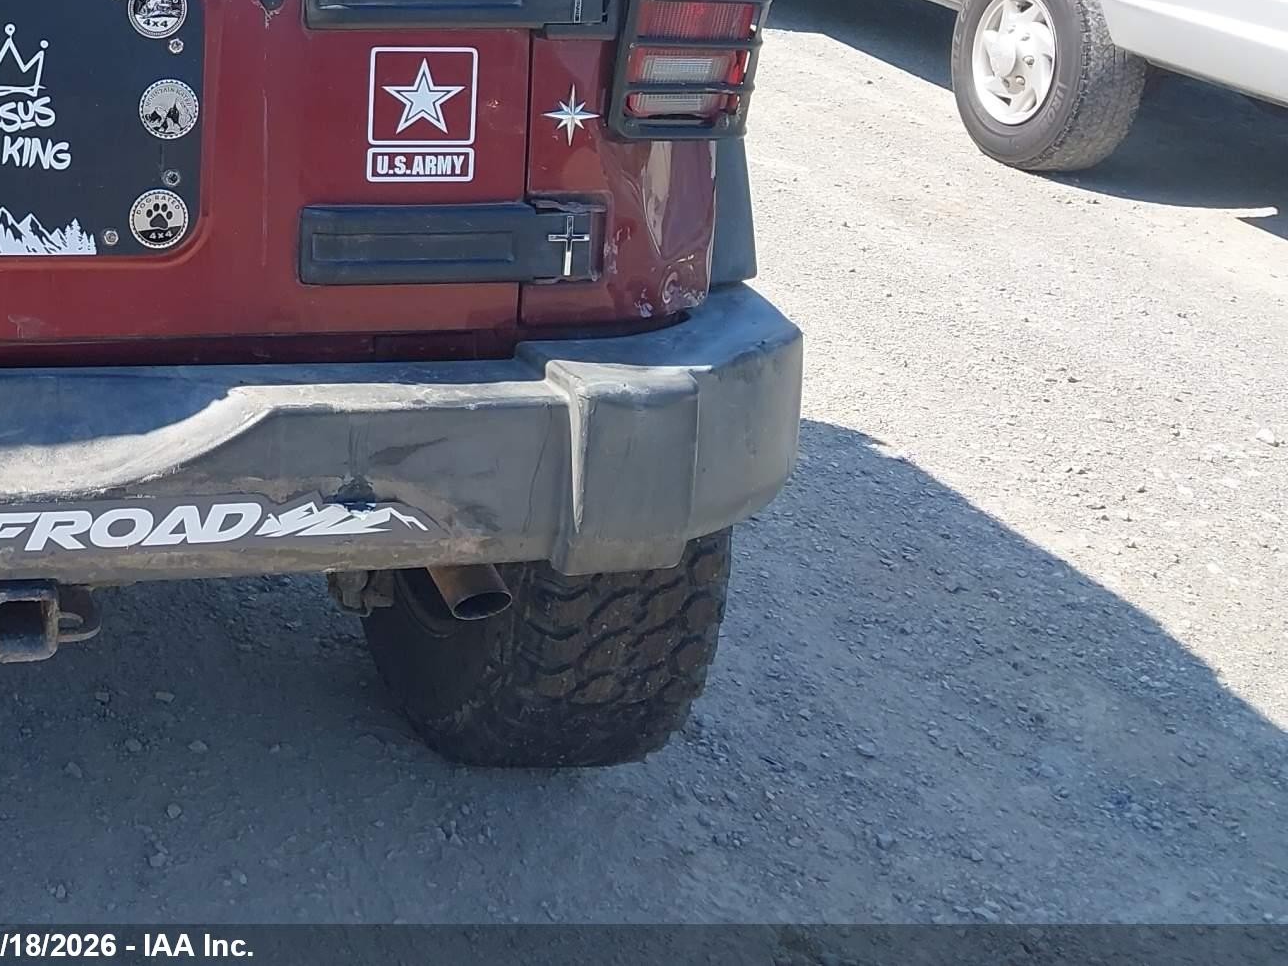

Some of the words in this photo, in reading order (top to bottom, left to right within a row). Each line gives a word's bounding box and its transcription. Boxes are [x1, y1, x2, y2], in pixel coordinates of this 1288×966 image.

[1, 135, 72, 170] KING
[136, 197, 152, 215] DOG
[154, 195, 181, 210] RATED
